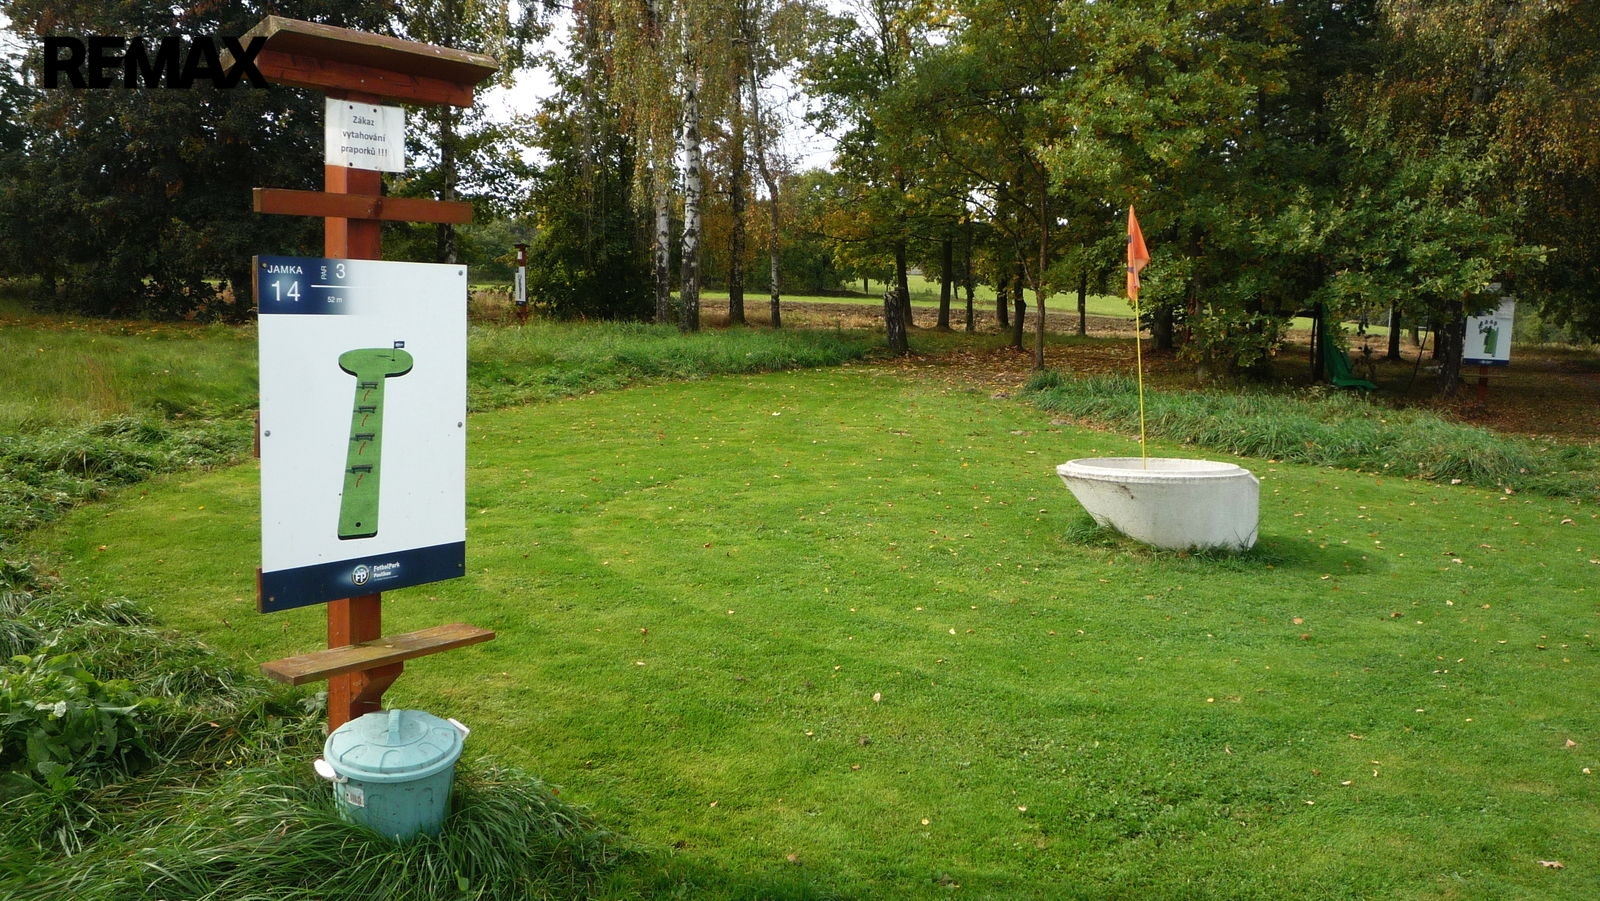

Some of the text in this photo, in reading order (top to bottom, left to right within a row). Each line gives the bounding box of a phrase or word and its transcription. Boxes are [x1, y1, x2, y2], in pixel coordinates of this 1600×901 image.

[353, 116, 375, 126] Zákaz
[343, 130, 386, 142] vytahování
[341, 146, 388, 157] praporků !!!
[267, 264, 303, 274] JAMKA
[335, 263, 346, 279] 3
[271, 280, 301, 302] 14
